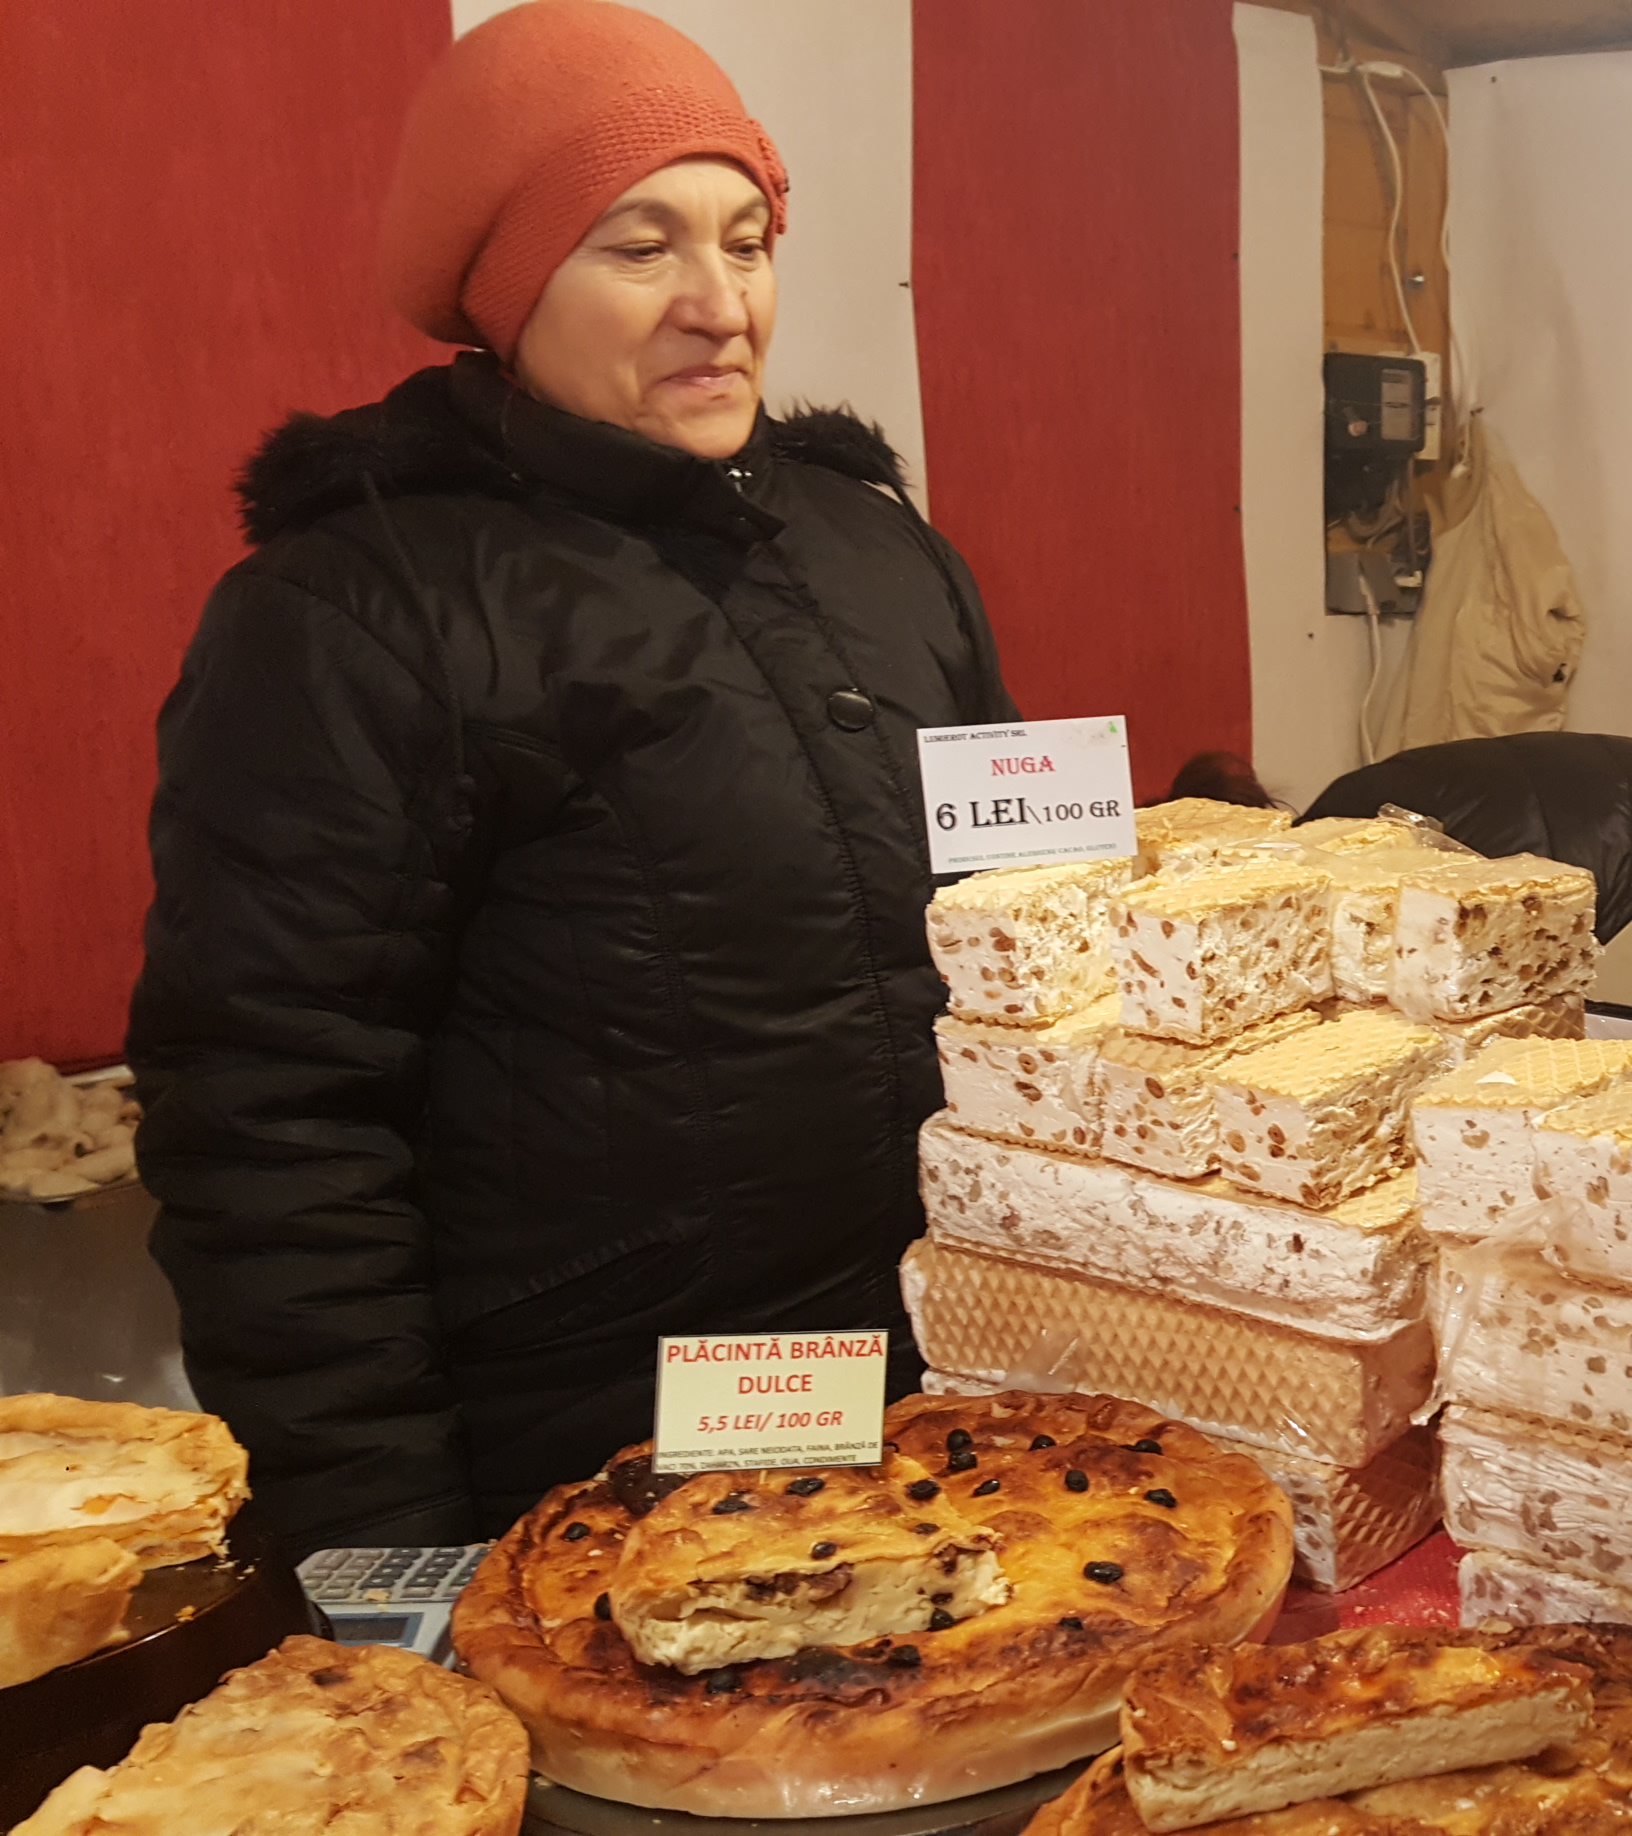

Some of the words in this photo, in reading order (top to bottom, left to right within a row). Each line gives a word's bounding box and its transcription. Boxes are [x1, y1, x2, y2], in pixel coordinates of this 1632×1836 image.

[991, 755, 1056, 776] NUGA
[936, 803, 957, 831] 6
[1090, 800, 1121, 818] GR
[666, 1337, 783, 1363] PLĂCINTĂ
[790, 1335, 884, 1359] BRÂNZĂ
[738, 1374, 813, 1394] DULCE
[698, 1415, 728, 1434] 5,5
[776, 1412, 811, 1428] 100
[816, 1411, 843, 1426] GR
